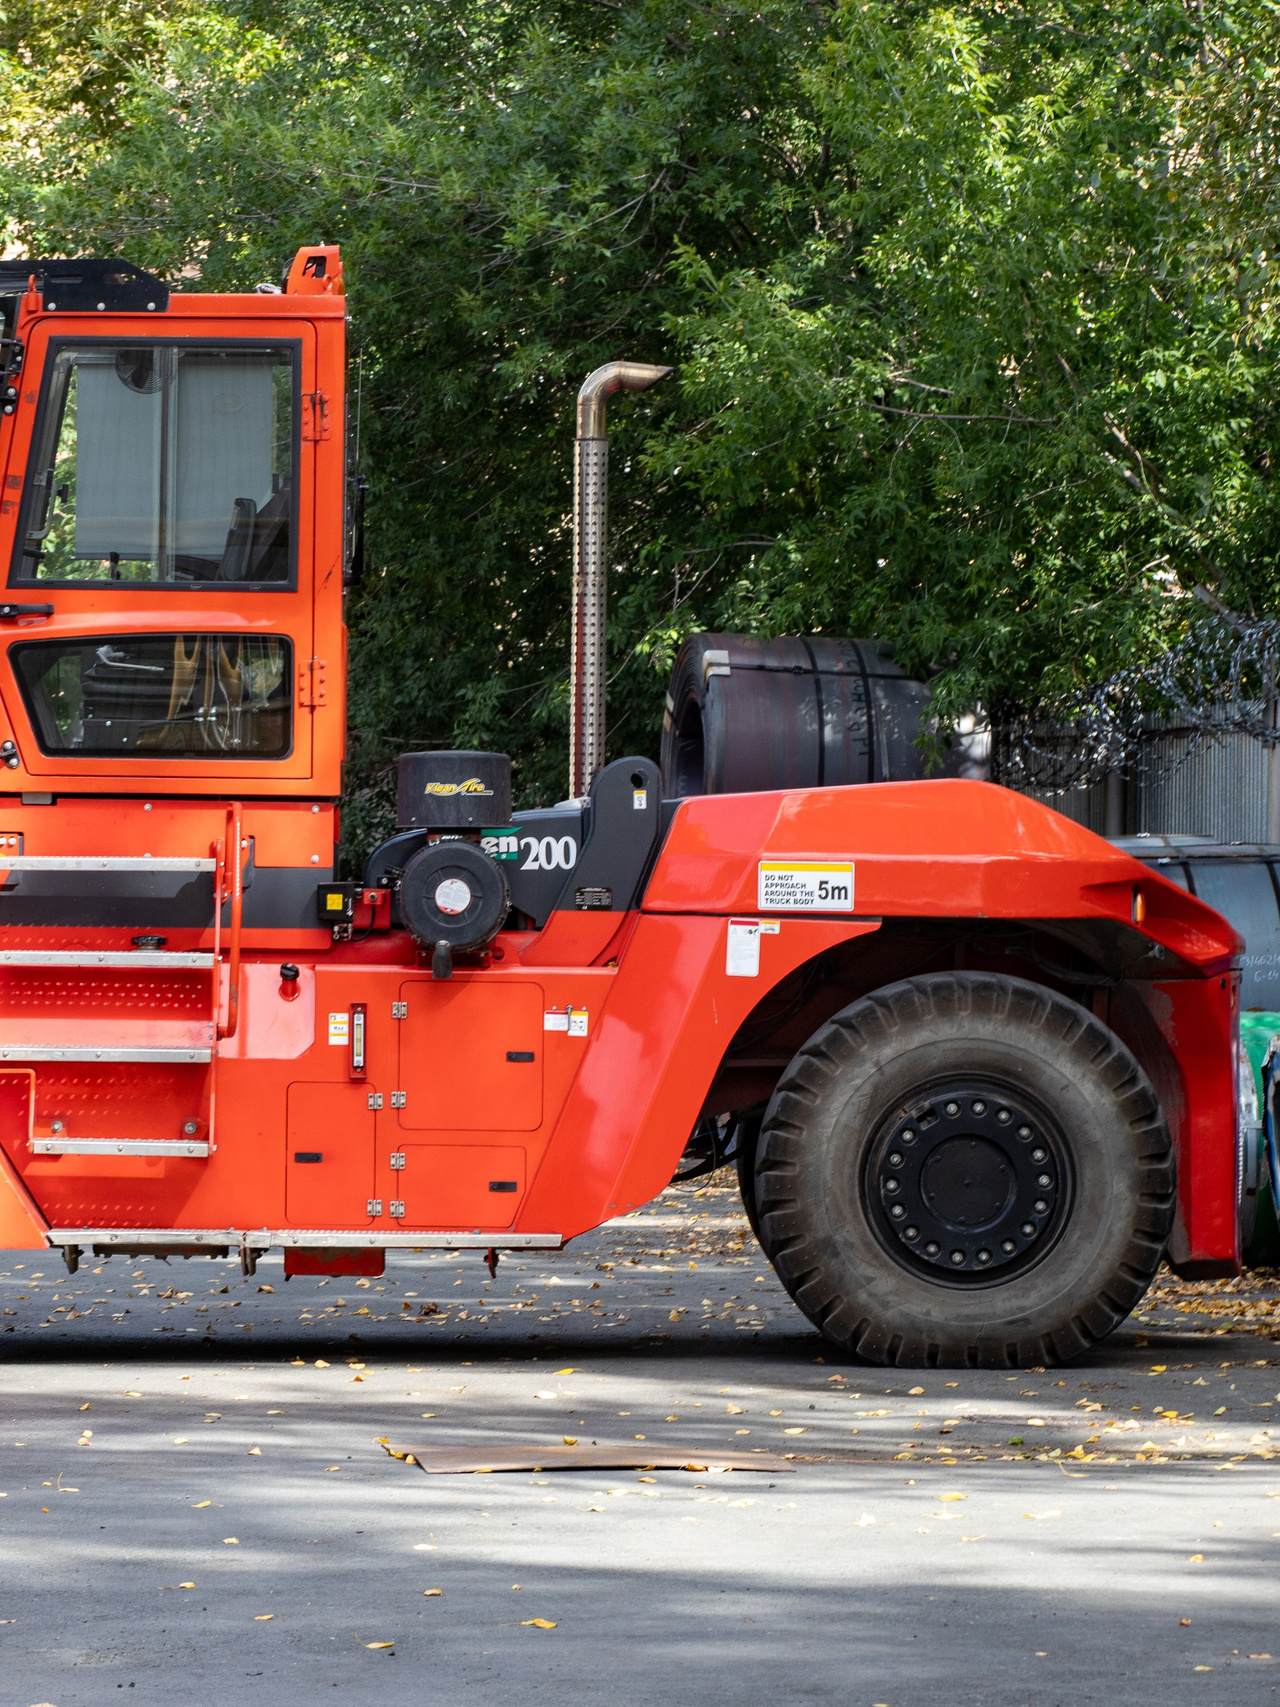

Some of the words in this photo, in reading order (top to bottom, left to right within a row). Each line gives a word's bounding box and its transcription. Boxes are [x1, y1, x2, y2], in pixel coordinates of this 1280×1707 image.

[481, 836, 518, 854] en
[520, 836, 577, 870] 200
[818, 880, 848, 900] 5m
